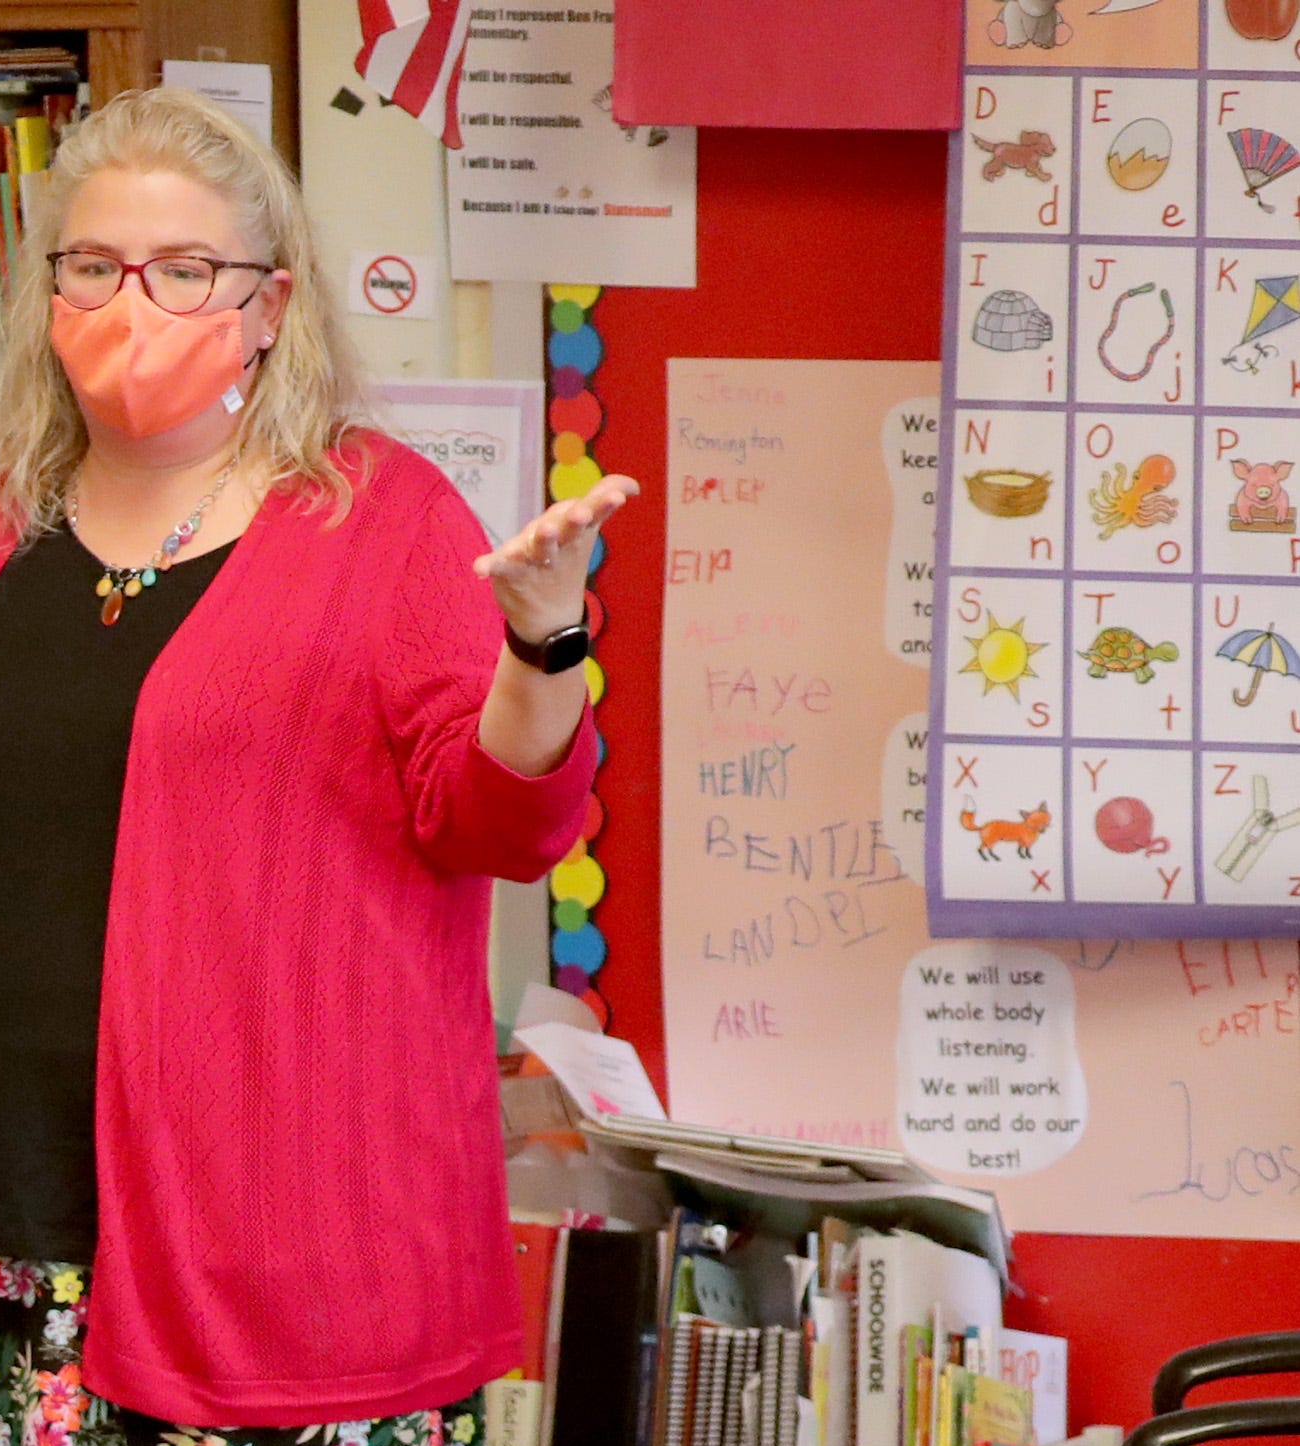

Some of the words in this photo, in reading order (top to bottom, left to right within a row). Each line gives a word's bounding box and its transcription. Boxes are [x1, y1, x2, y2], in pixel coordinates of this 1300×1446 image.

[506, 11, 564, 23] represent
[567, 11, 590, 22] Ben
[469, 70, 490, 82] will
[493, 71, 506, 82] be
[976, 87, 997, 119] D
[1093, 90, 1113, 122] E
[1218, 92, 1240, 125] F
[469, 113, 490, 125] will
[493, 114, 506, 125] be
[510, 115, 583, 127] responsible.
[469, 156, 490, 168] will
[493, 157, 506, 168] be
[510, 158, 537, 170] safe.
[463, 200, 511, 213] Because
[970, 254, 988, 286] I
[1089, 259, 1116, 289] J
[1218, 259, 1239, 292] K
[902, 414, 937, 432] We
[965, 421, 991, 454] N
[453, 437, 495, 461] Song
[1087, 424, 1113, 457] O
[1216, 428, 1239, 460] P
[958, 588, 981, 622] S
[1084, 593, 1115, 625] T
[1214, 595, 1240, 628] U
[699, 741, 797, 799] HENRY
[954, 756, 979, 788] X
[1083, 760, 1107, 791] Y
[1213, 764, 1241, 794] Z
[920, 966, 955, 985] We
[966, 967, 999, 985] will
[1010, 970, 1045, 985] use
[926, 1002, 983, 1021] whole
[995, 1002, 1045, 1025] body
[921, 1078, 956, 1095] We
[967, 1078, 999, 1095] will
[1010, 1078, 1060, 1096] work
[906, 1114, 954, 1132] hard
[965, 1114, 1000, 1132] and
[1012, 1114, 1035, 1132] do
[1047, 1118, 1080, 1132] our
[969, 1150, 1020, 1168] best!
